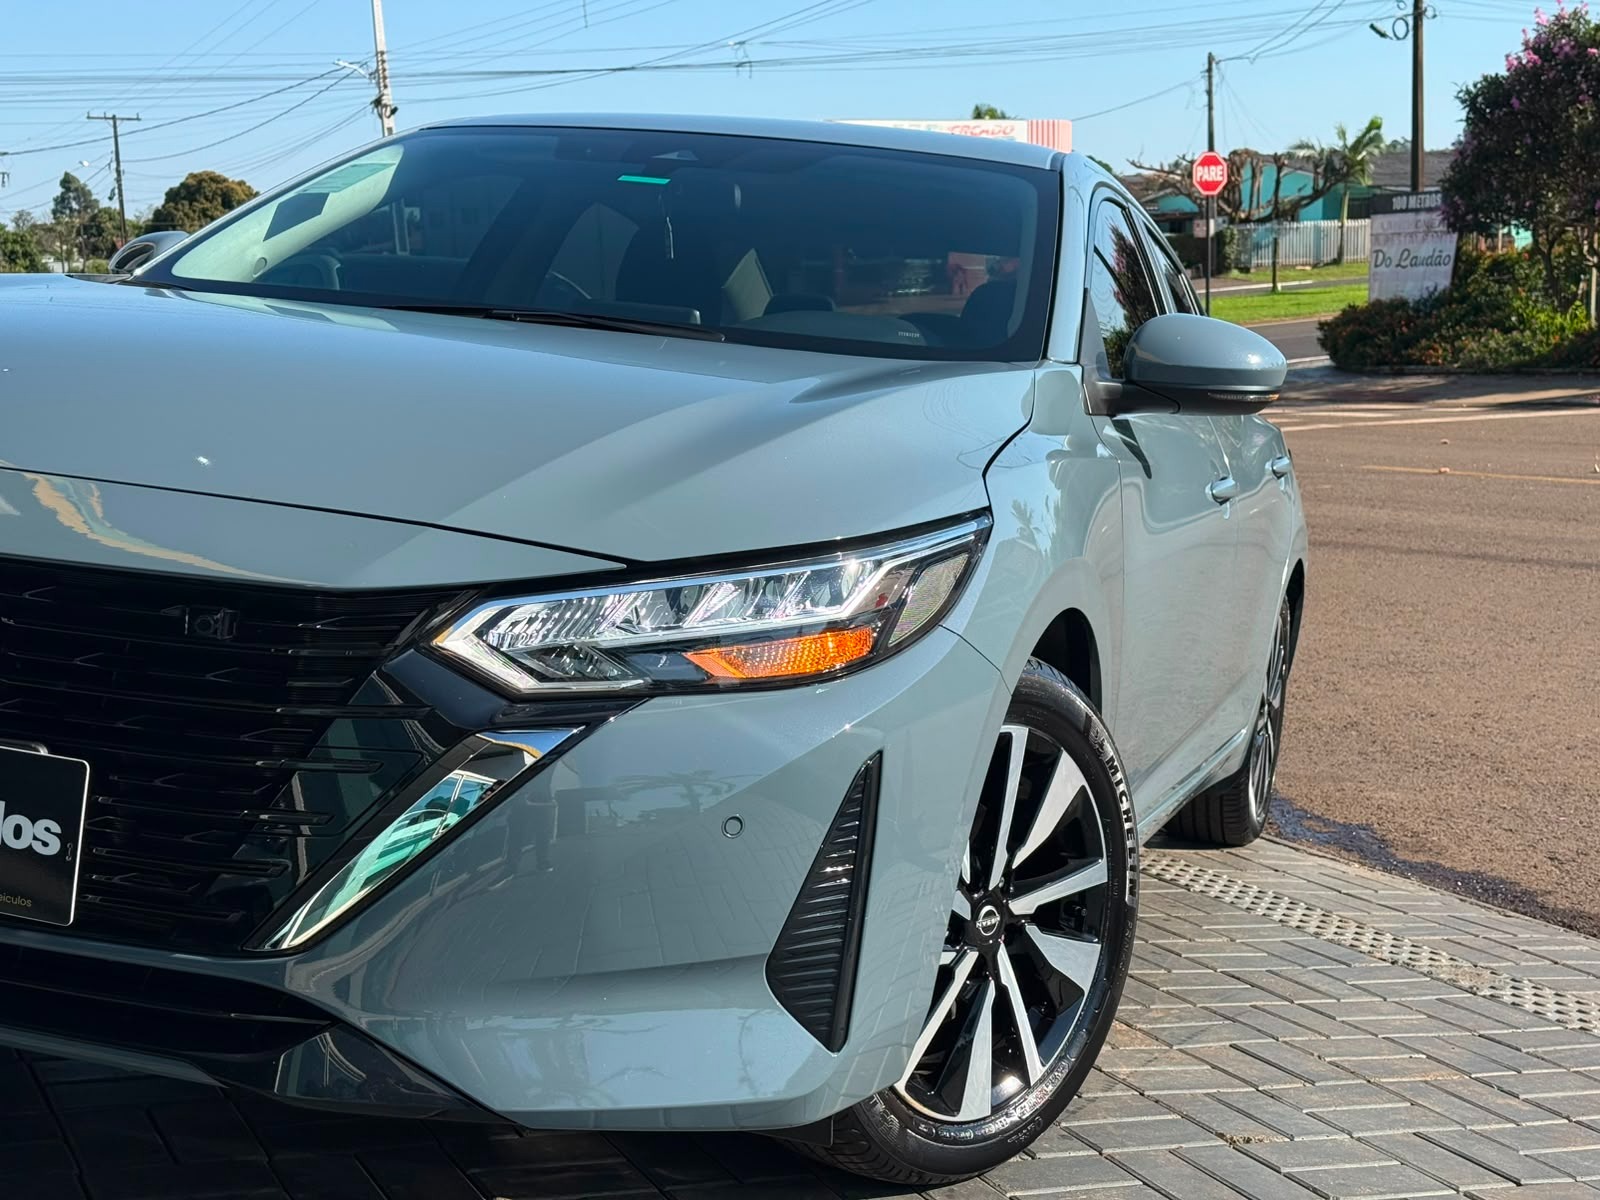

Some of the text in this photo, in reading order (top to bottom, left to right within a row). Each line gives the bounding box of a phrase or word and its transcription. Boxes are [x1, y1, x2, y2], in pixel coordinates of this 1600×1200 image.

[1196, 165, 1223, 182] PARE
[1392, 193, 1442, 210] 100 METROS
[1373, 249, 1392, 268] Do
[1105, 754, 1137, 898] MICHELIN
